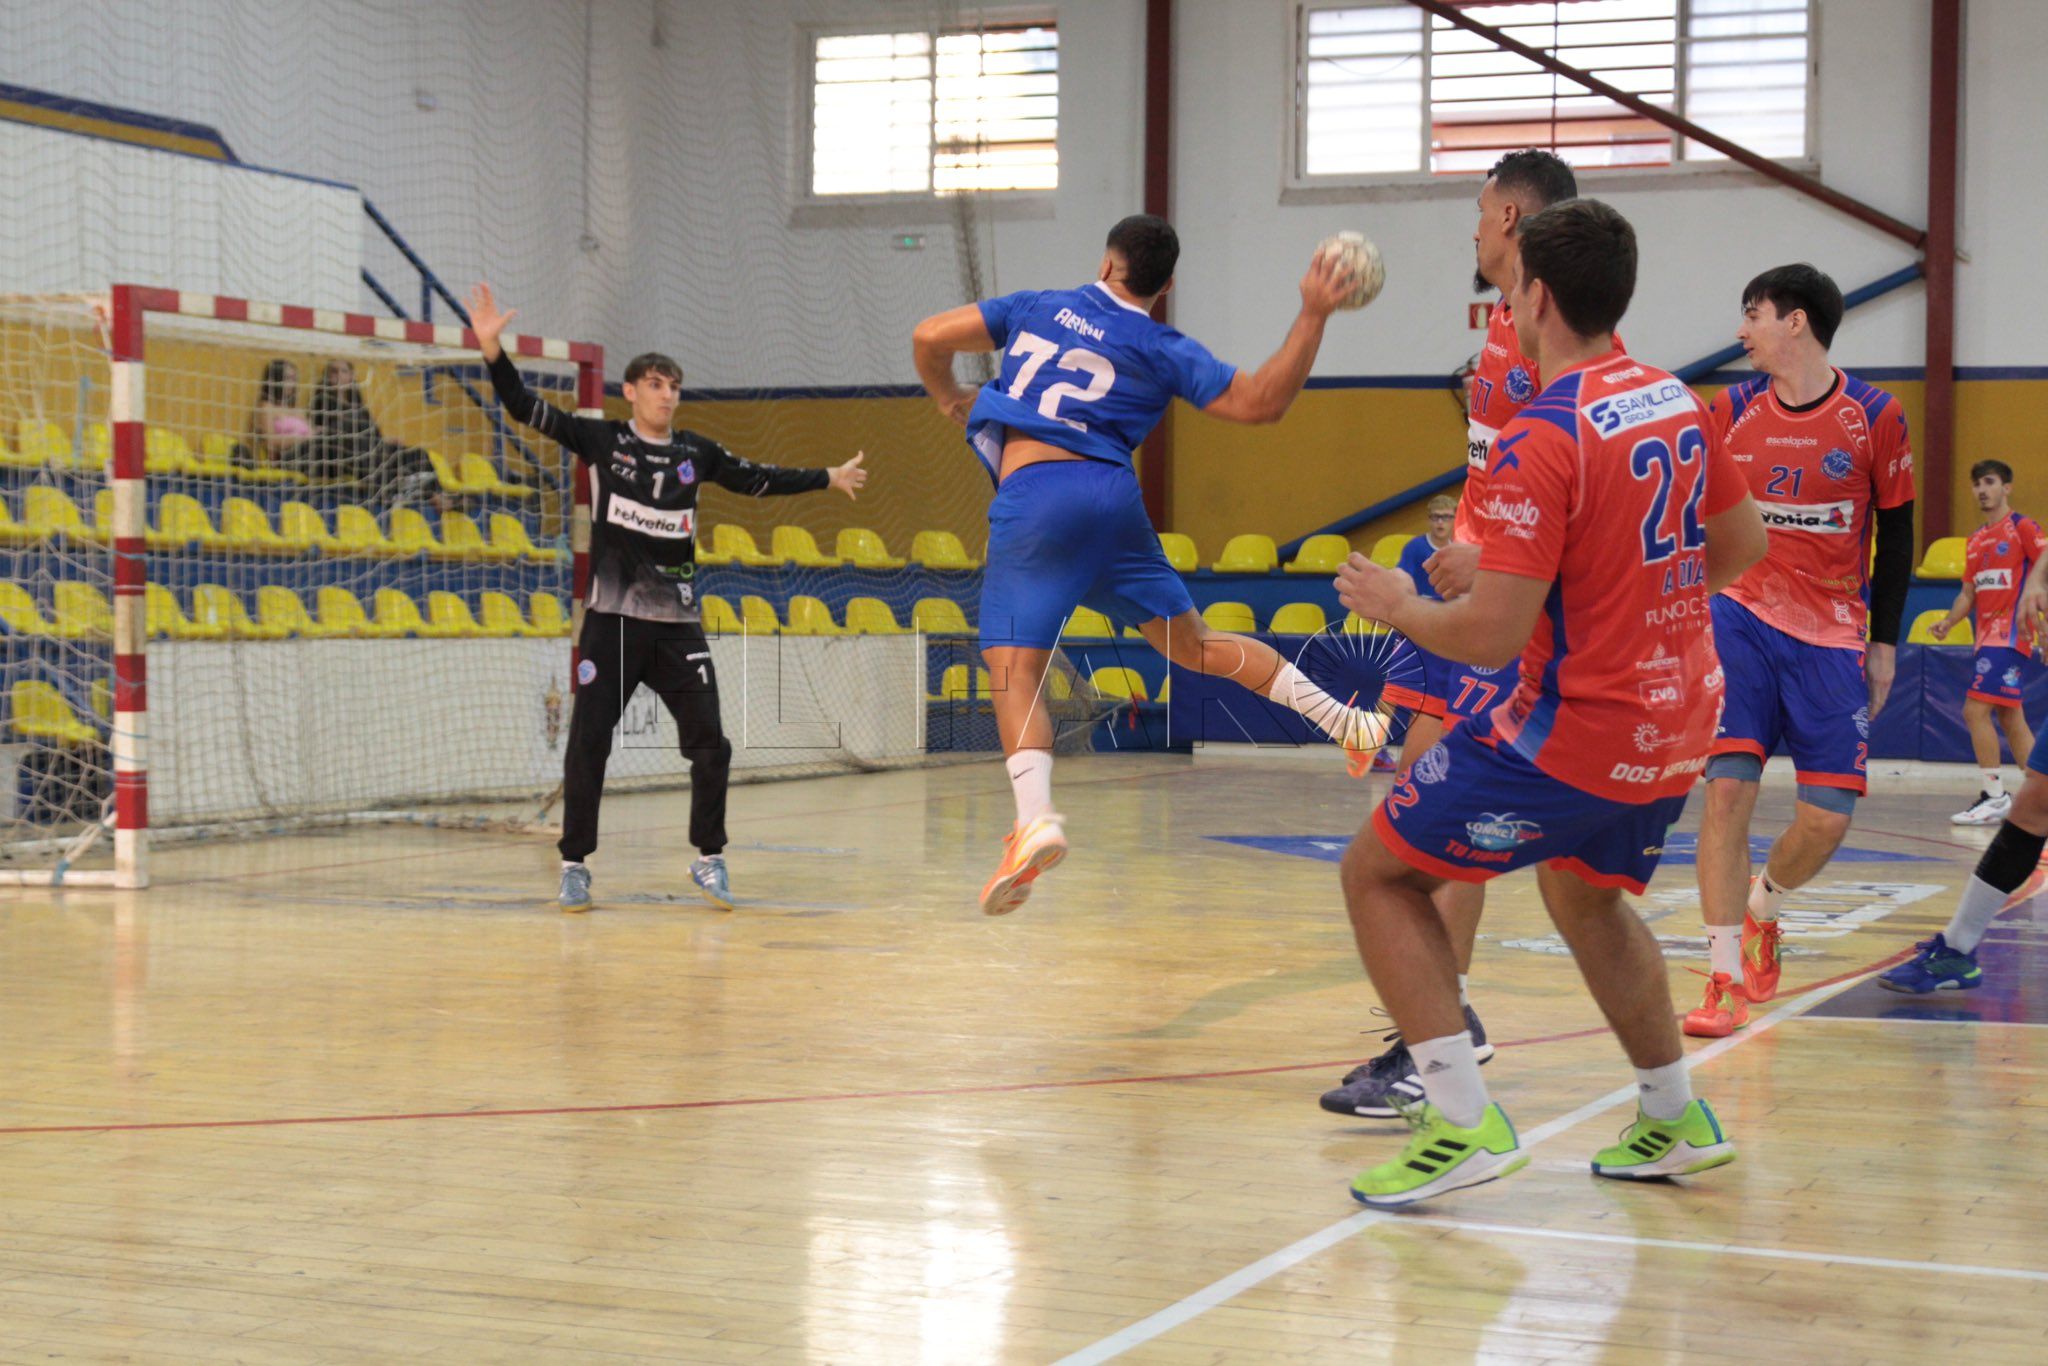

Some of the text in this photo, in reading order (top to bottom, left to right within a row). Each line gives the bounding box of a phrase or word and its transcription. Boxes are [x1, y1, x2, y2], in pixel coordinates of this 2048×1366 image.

[1007, 331, 1116, 434] 72
[1473, 377, 1494, 416] 77
[652, 471, 665, 500] 1
[1630, 424, 1707, 566] 22
[1766, 465, 1804, 498] 21
[614, 504, 675, 532] helvetia
[697, 665, 708, 684] 1
[1452, 675, 1499, 715] 77
[1609, 762, 1660, 784] DOS
